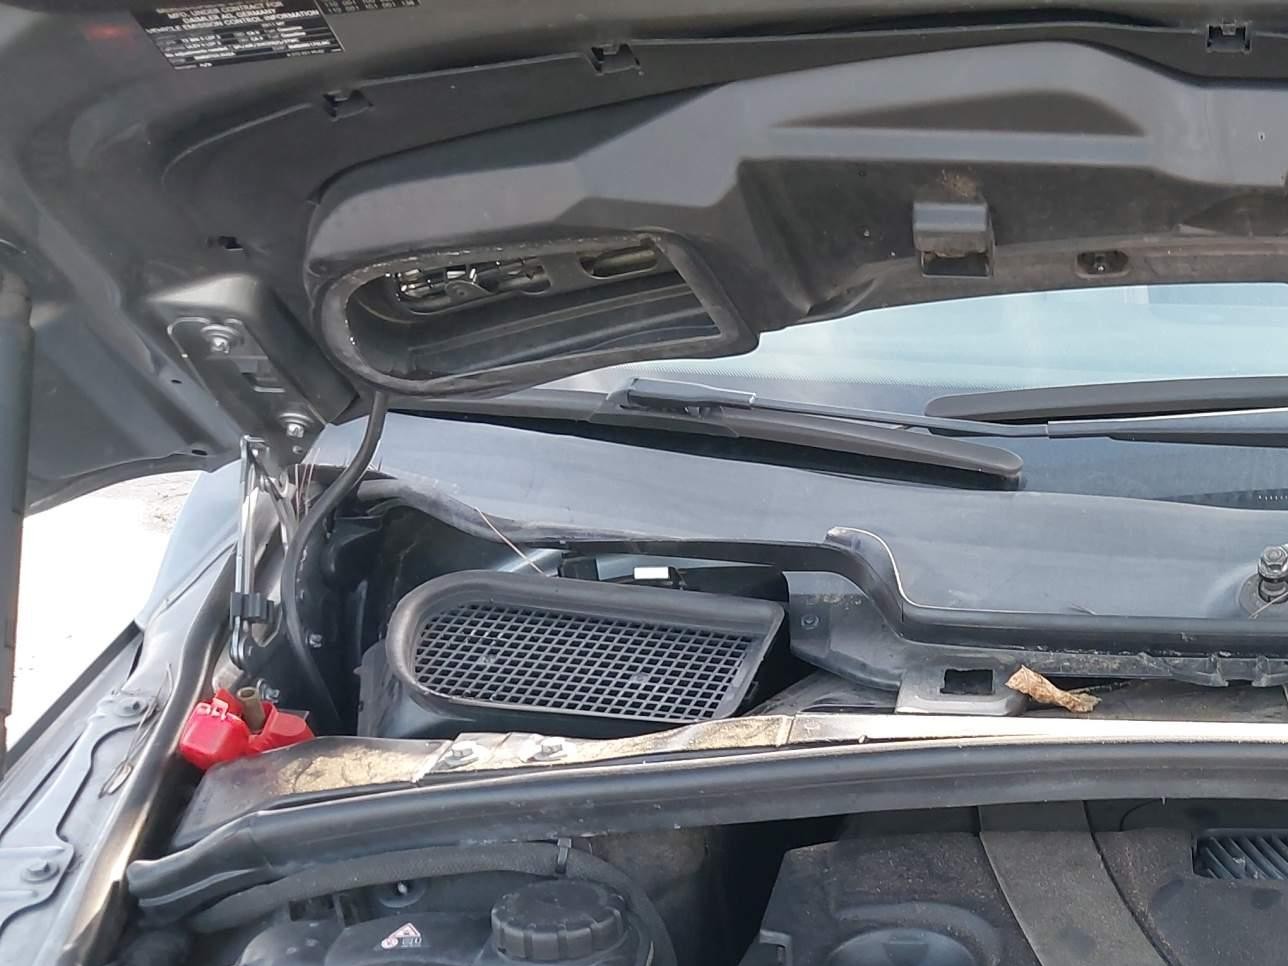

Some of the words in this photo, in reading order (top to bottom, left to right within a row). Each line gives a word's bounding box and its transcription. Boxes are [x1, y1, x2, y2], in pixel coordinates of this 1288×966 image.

[182, 14, 220, 24] DAIMLER
[236, 8, 277, 18] GERMANY
[191, 8, 220, 17] UNDER
[220, 2, 264, 13] CONTRACT
[145, 25, 182, 34] VEHICLE
[183, 21, 224, 31] EMISSION
[224, 16, 264, 26] CONTROL
[264, 9, 320, 21] INFORMATION
